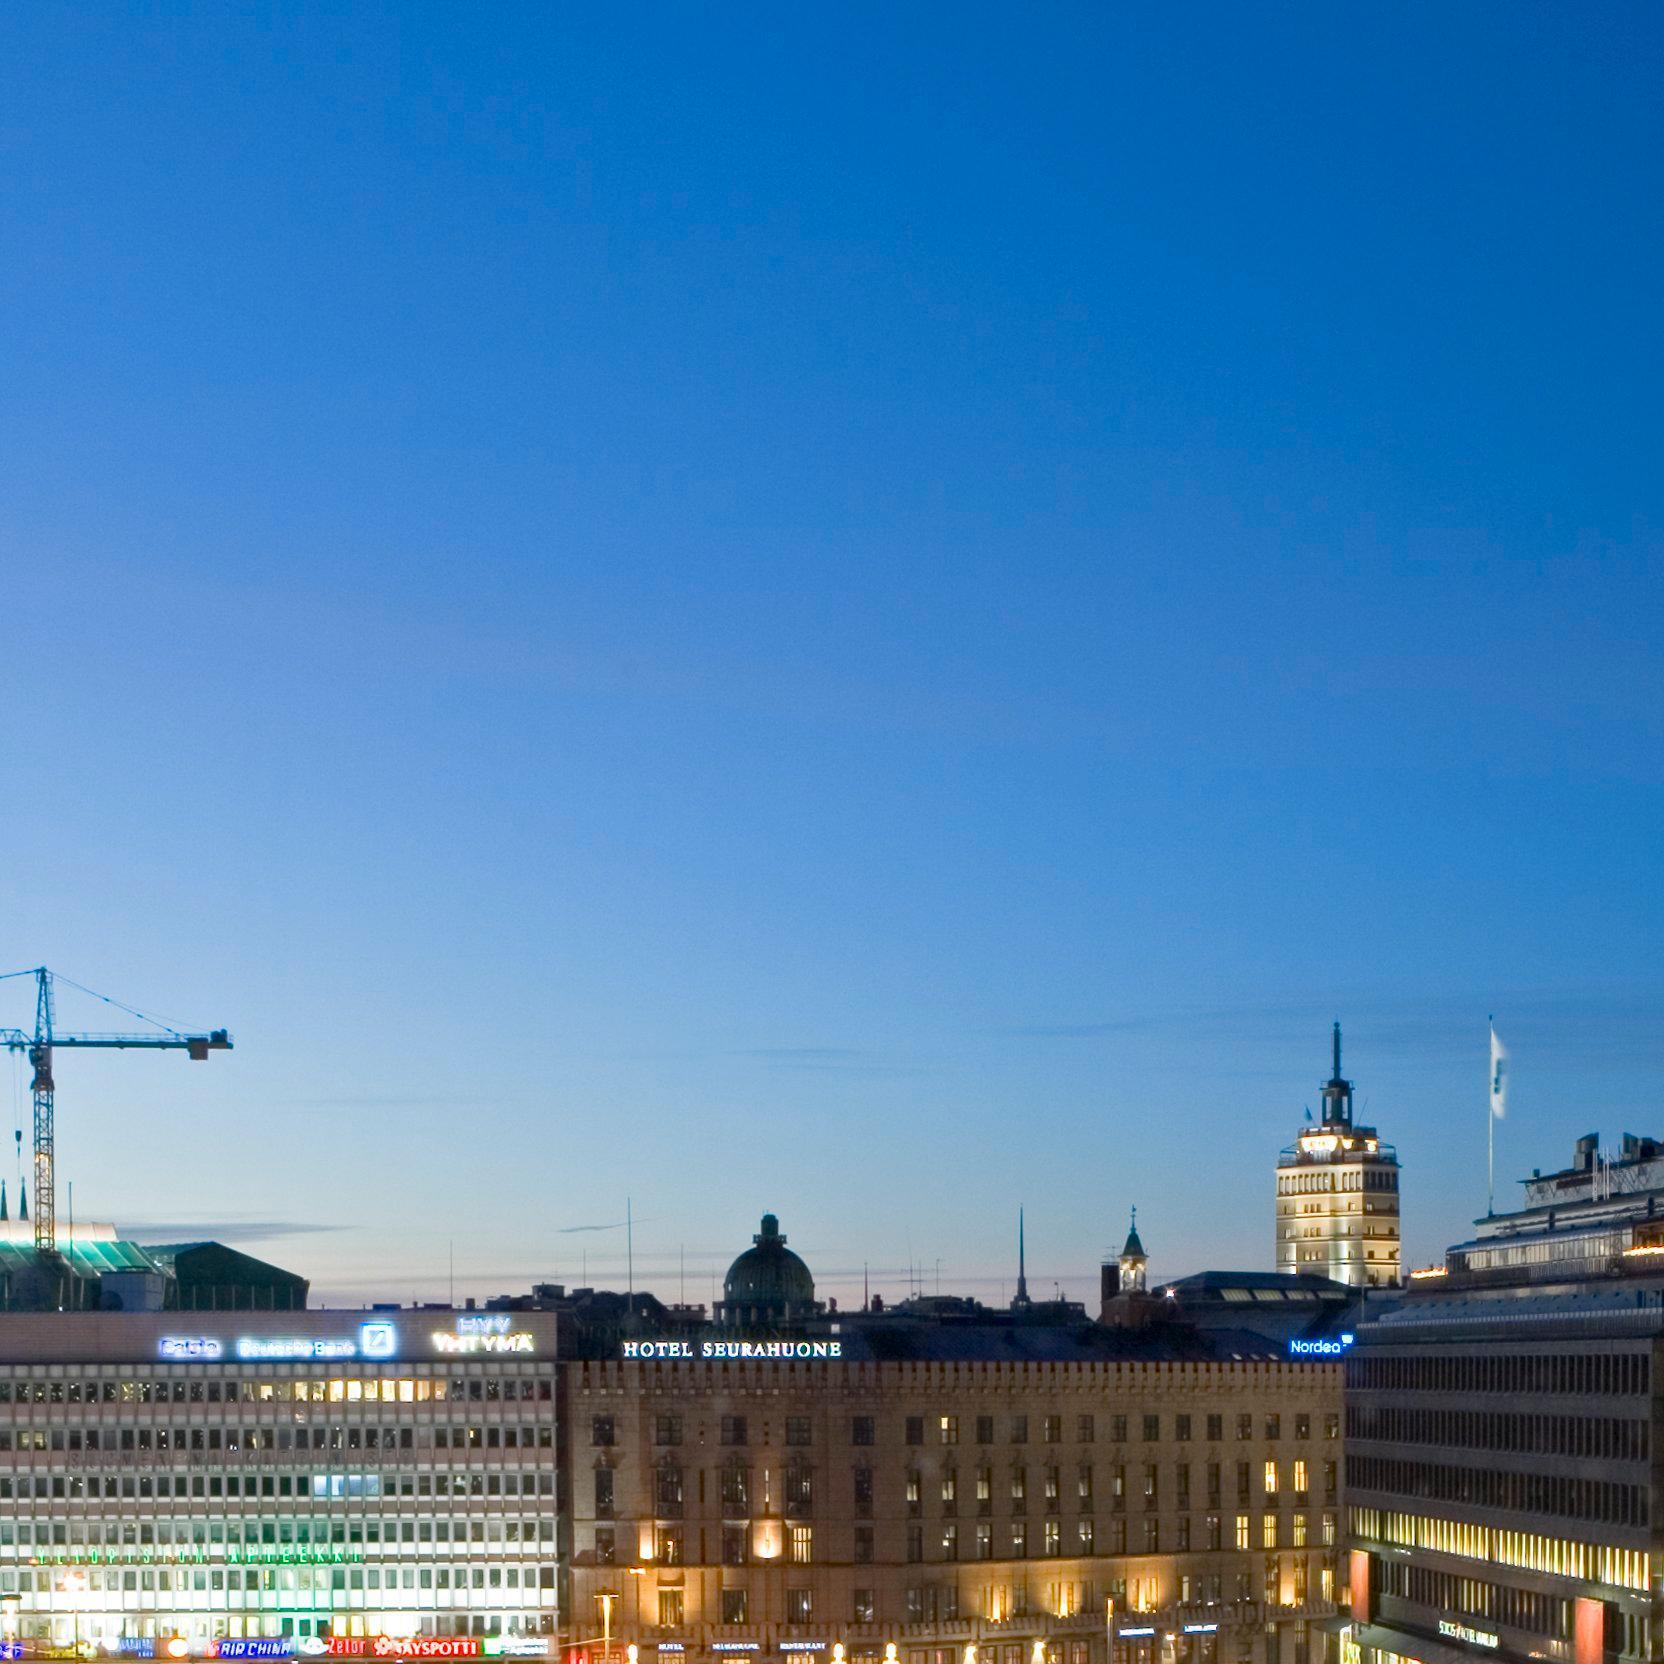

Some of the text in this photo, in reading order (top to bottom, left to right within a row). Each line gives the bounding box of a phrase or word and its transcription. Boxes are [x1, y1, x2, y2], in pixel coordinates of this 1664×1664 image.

[623, 1341, 842, 1358] HOTEL SEURAHUONE
[1291, 1340, 1340, 1353] Nordea
[230, 1546, 360, 1564] APTEEKKI
[220, 1640, 291, 1657] AIR CHINA
[327, 1637, 366, 1654] Zetor
